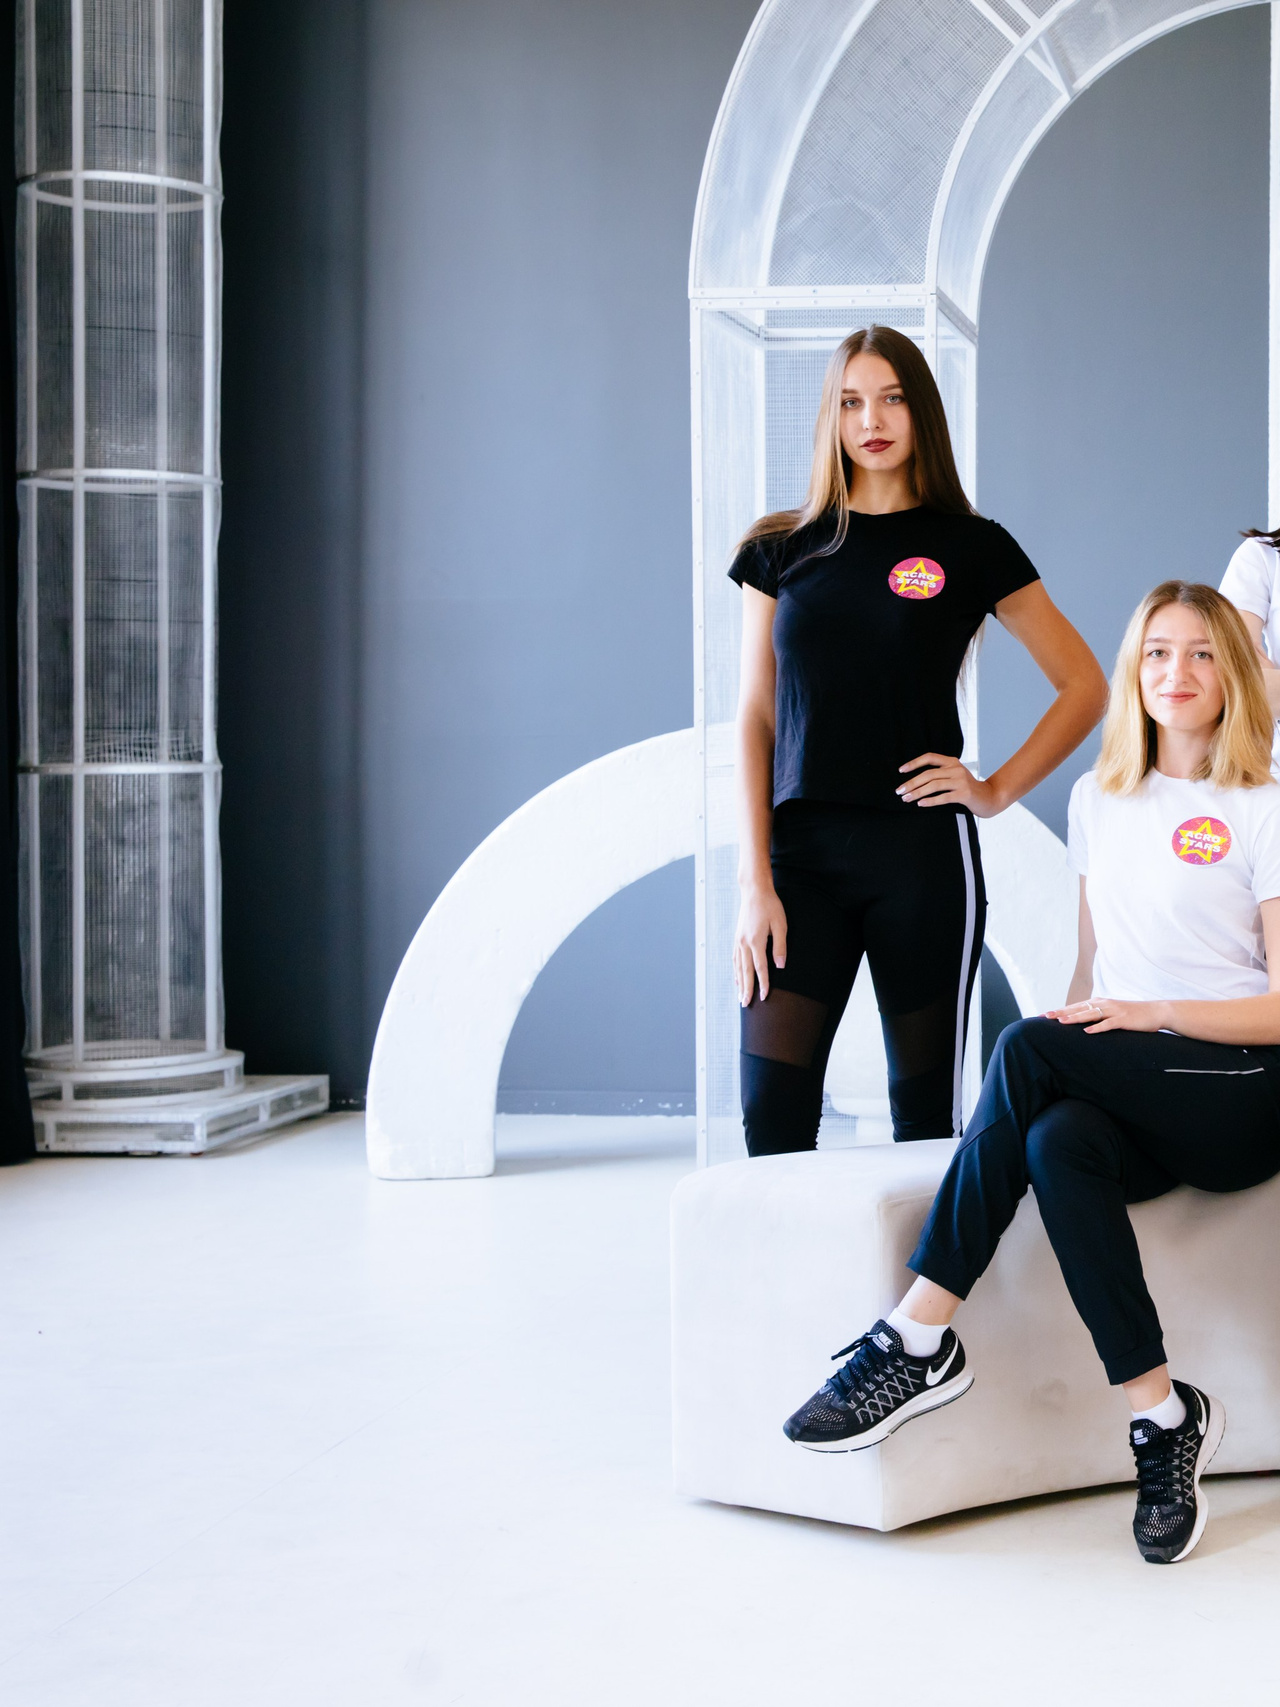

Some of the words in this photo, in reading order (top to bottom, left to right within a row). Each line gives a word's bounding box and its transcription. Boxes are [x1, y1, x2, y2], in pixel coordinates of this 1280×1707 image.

[902, 571, 935, 581] ACRO
[896, 577, 937, 588] STARS
[1185, 831, 1221, 844] ACRO
[1179, 837, 1221, 853] STARS
